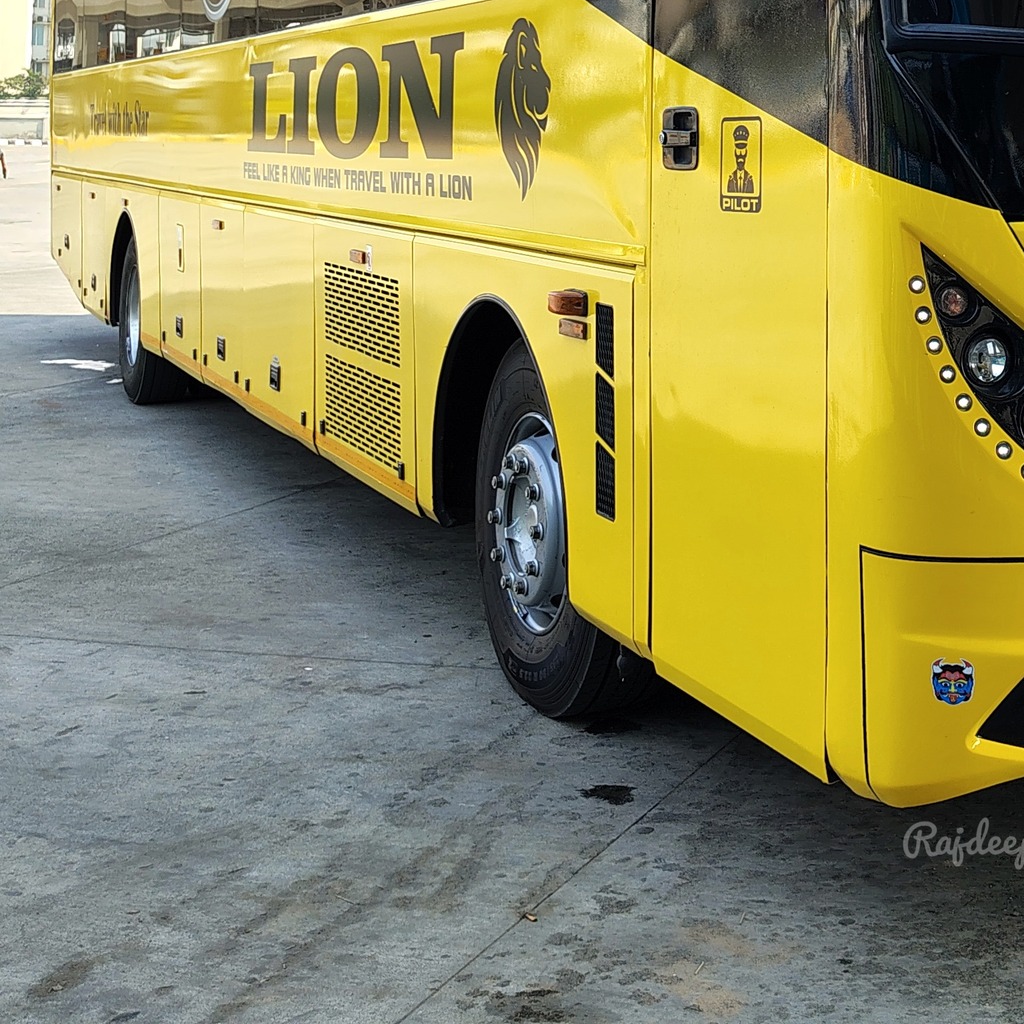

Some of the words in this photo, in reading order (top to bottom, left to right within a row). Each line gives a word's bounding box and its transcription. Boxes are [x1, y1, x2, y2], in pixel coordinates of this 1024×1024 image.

[247, 31, 465, 160] LION
[243, 161, 261, 181] FEEL
[262, 163, 280, 183] LIKE
[282, 164, 288, 183] A
[290, 165, 311, 186] KING
[313, 167, 341, 189] WHEN
[344, 169, 387, 193] TRAVEL
[390, 171, 421, 195] WITH
[425, 173, 435, 197] A
[439, 174, 473, 201] LION
[722, 197, 759, 212] PILOT
